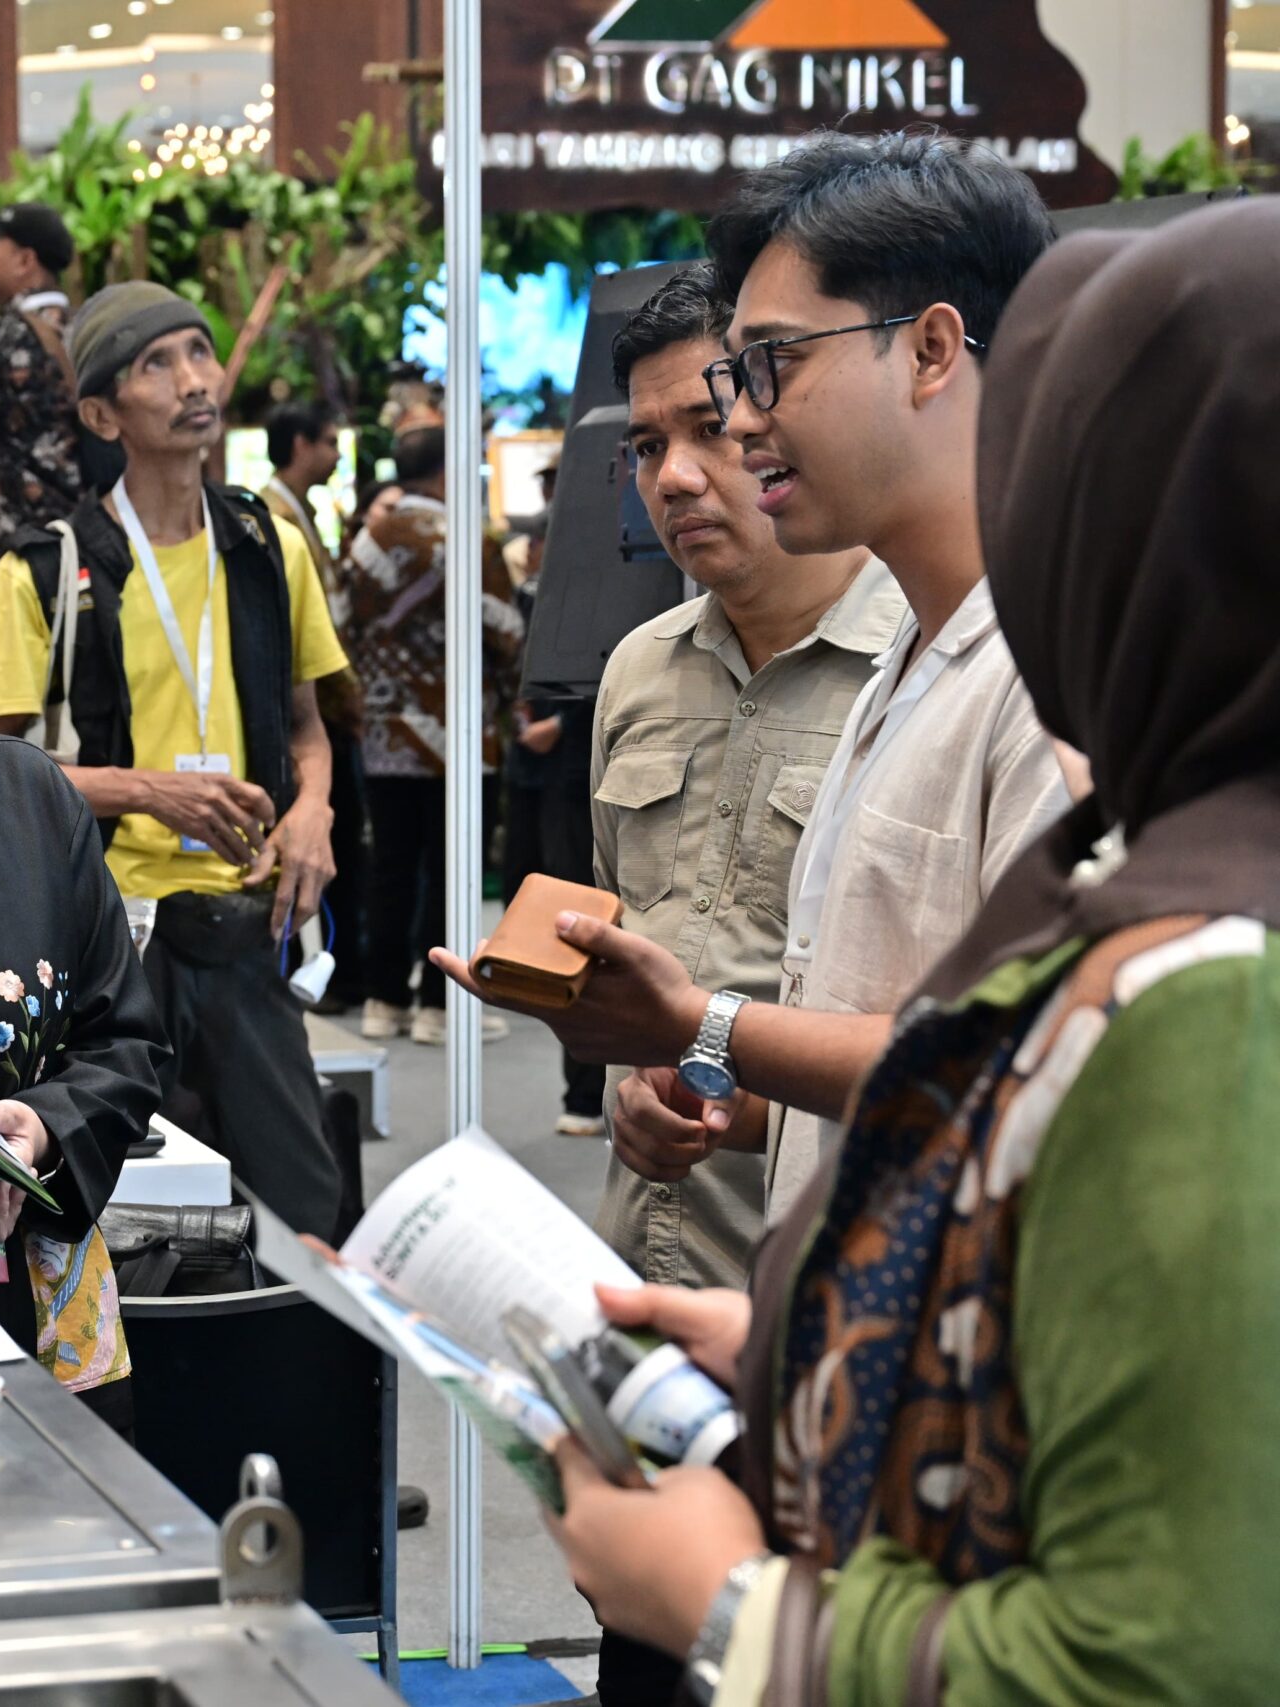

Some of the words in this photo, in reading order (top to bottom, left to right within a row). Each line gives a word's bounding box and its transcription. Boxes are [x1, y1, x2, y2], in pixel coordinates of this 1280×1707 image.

[543, 48, 622, 105] PT
[643, 49, 777, 115] GAG
[800, 53, 980, 117] NIKEL
